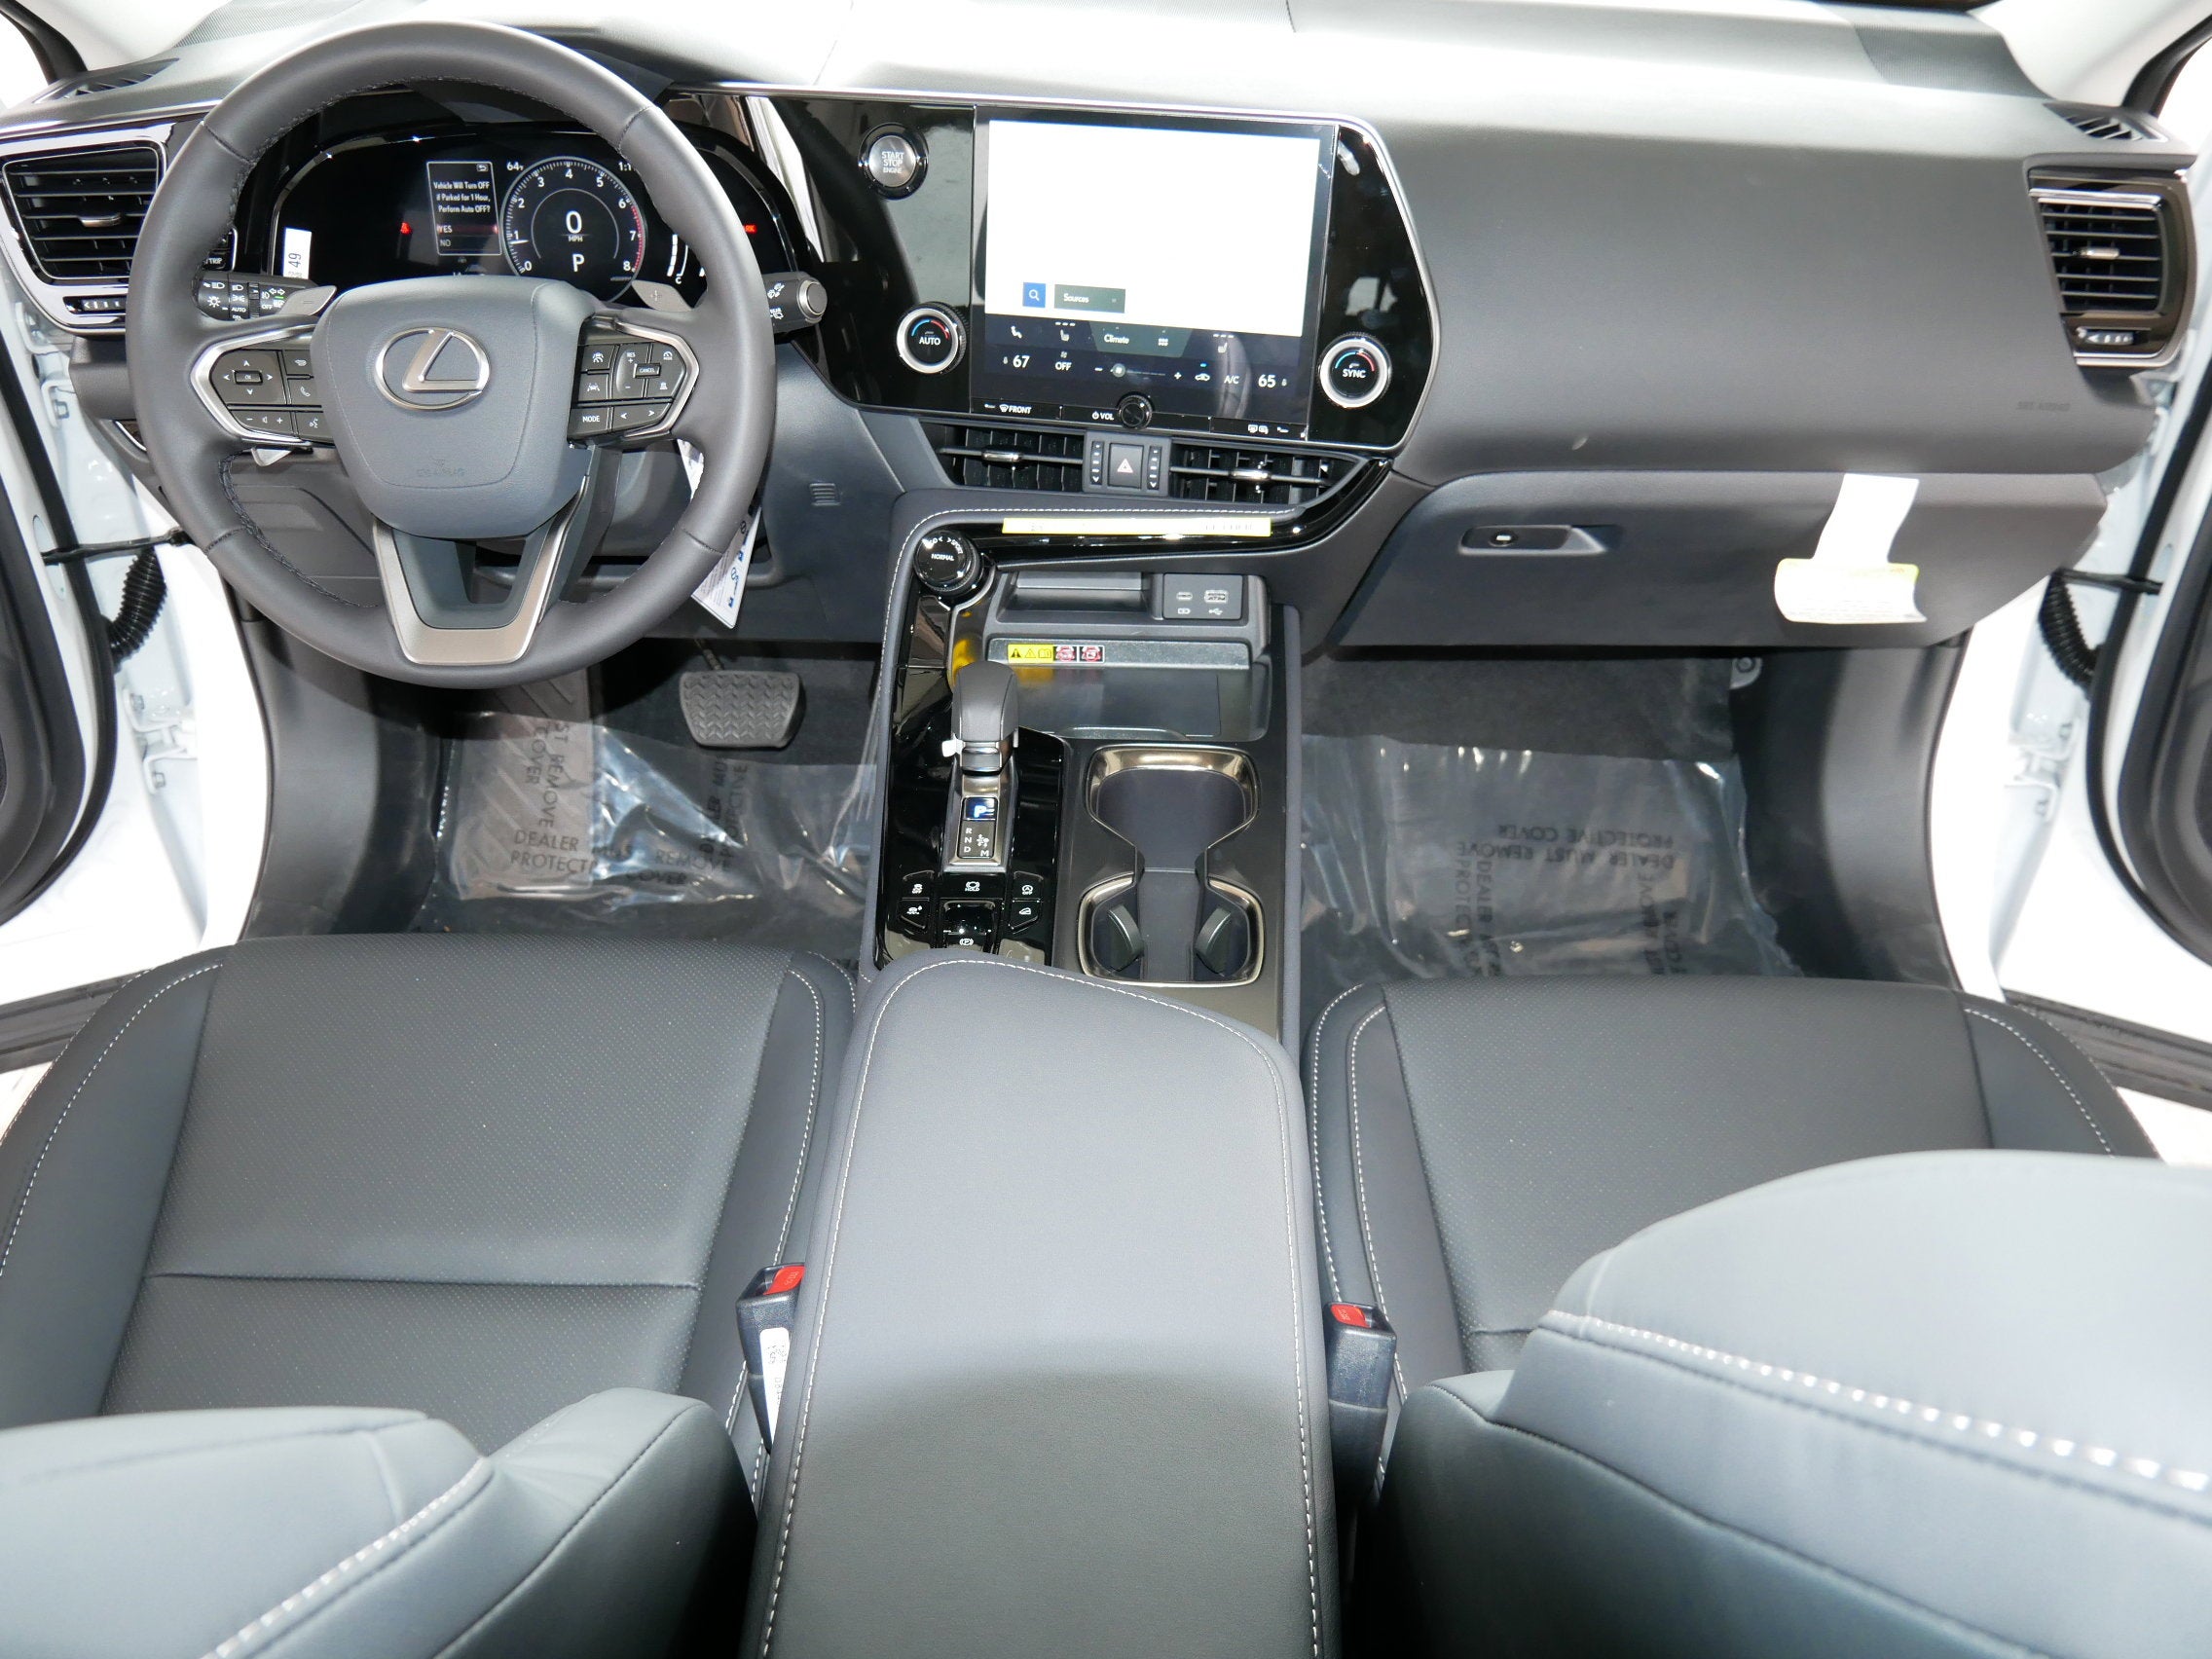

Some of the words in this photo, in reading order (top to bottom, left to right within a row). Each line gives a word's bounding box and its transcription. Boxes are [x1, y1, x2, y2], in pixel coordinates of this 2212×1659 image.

[881, 151, 904, 160] START
[883, 159, 903, 167] STOP
[565, 169, 573, 179] 4
[477, 181, 490, 190] OFF
[537, 177, 545, 188] 3
[596, 176, 604, 188] 5
[517, 198, 526, 208] 2
[617, 198, 626, 208] 6
[438, 204, 461, 213] Perform
[565, 210, 583, 235] 0
[629, 230, 636, 240] 7
[439, 239, 452, 247] NO
[287, 252, 302, 268] 49
[571, 253, 585, 272] P
[524, 261, 533, 272] 0
[623, 261, 631, 272] 8
[1063, 292, 1089, 304] Sources
[918, 336, 941, 346] AUTO
[1103, 333, 1130, 346] Climate
[1013, 354, 1031, 369] 67
[1054, 361, 1072, 371] OFF
[1343, 369, 1366, 378] SYNC
[1223, 375, 1240, 385] A/C
[1257, 374, 1276, 388] 65
[1009, 404, 1032, 415] FRONT
[1099, 412, 1115, 422] VOL
[931, 553, 955, 562] NORMAL
[538, 753, 566, 829] REMOVE
[973, 804, 987, 819] P
[513, 828, 580, 853] DEALER
